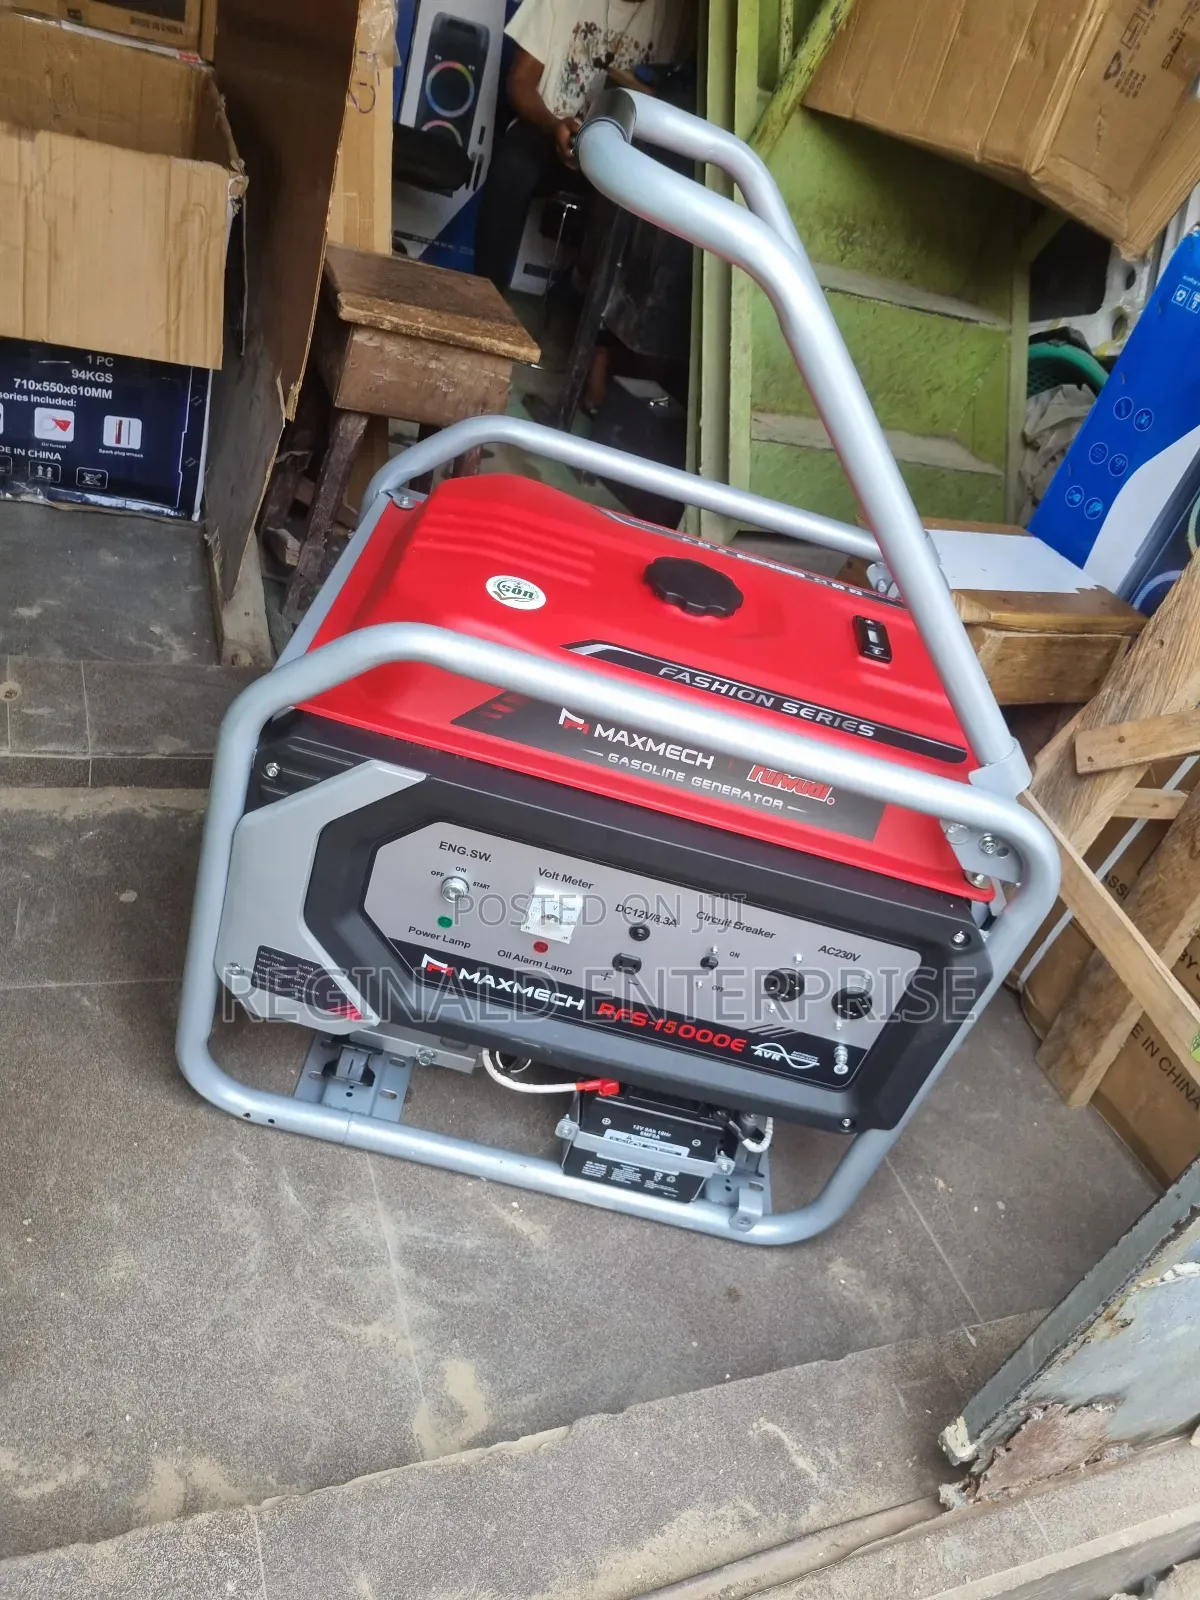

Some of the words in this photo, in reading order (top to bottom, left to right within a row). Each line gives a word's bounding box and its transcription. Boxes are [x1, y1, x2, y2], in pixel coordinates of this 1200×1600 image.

[87, 354, 93, 364] 1
[96, 356, 114, 367] PC
[71, 369, 114, 383] 94KGS
[13, 378, 112, 399] 710x550x610MM
[31, 394, 77, 407] Included:
[13, 447, 26, 456] IN
[27, 449, 62, 460] CHINA
[658, 666, 776, 708] FASHION
[779, 701, 877, 738] SERIES
[593, 723, 715, 771] MAXMECH
[607, 752, 687, 785] GASOLINE
[691, 774, 784, 810] GENERATOR
[439, 840, 493, 864] ENG.SW.
[430, 869, 445, 878] OFF
[455, 866, 467, 874] ON
[538, 867, 561, 882] Volt
[562, 874, 594, 890] Meter
[472, 881, 491, 890] START
[696, 910, 732, 928] Circuit
[733, 921, 776, 940] Breaker
[408, 925, 440, 941] Power
[441, 934, 471, 949] Lamp
[497, 948, 511, 960] Oil
[511, 953, 543, 969] Alarm
[545, 961, 573, 976] Lamp
[729, 951, 741, 959] ON
[817, 944, 861, 963] AC230V
[459, 967, 585, 1011] MAXMECH
[711, 984, 725, 993] OFF
[597, 1002, 747, 1053] RFS-15000E
[754, 1049, 781, 1062] AVR
[1142, 1036, 1160, 1058] IN
[1157, 1055, 1200, 1111] CHINA
